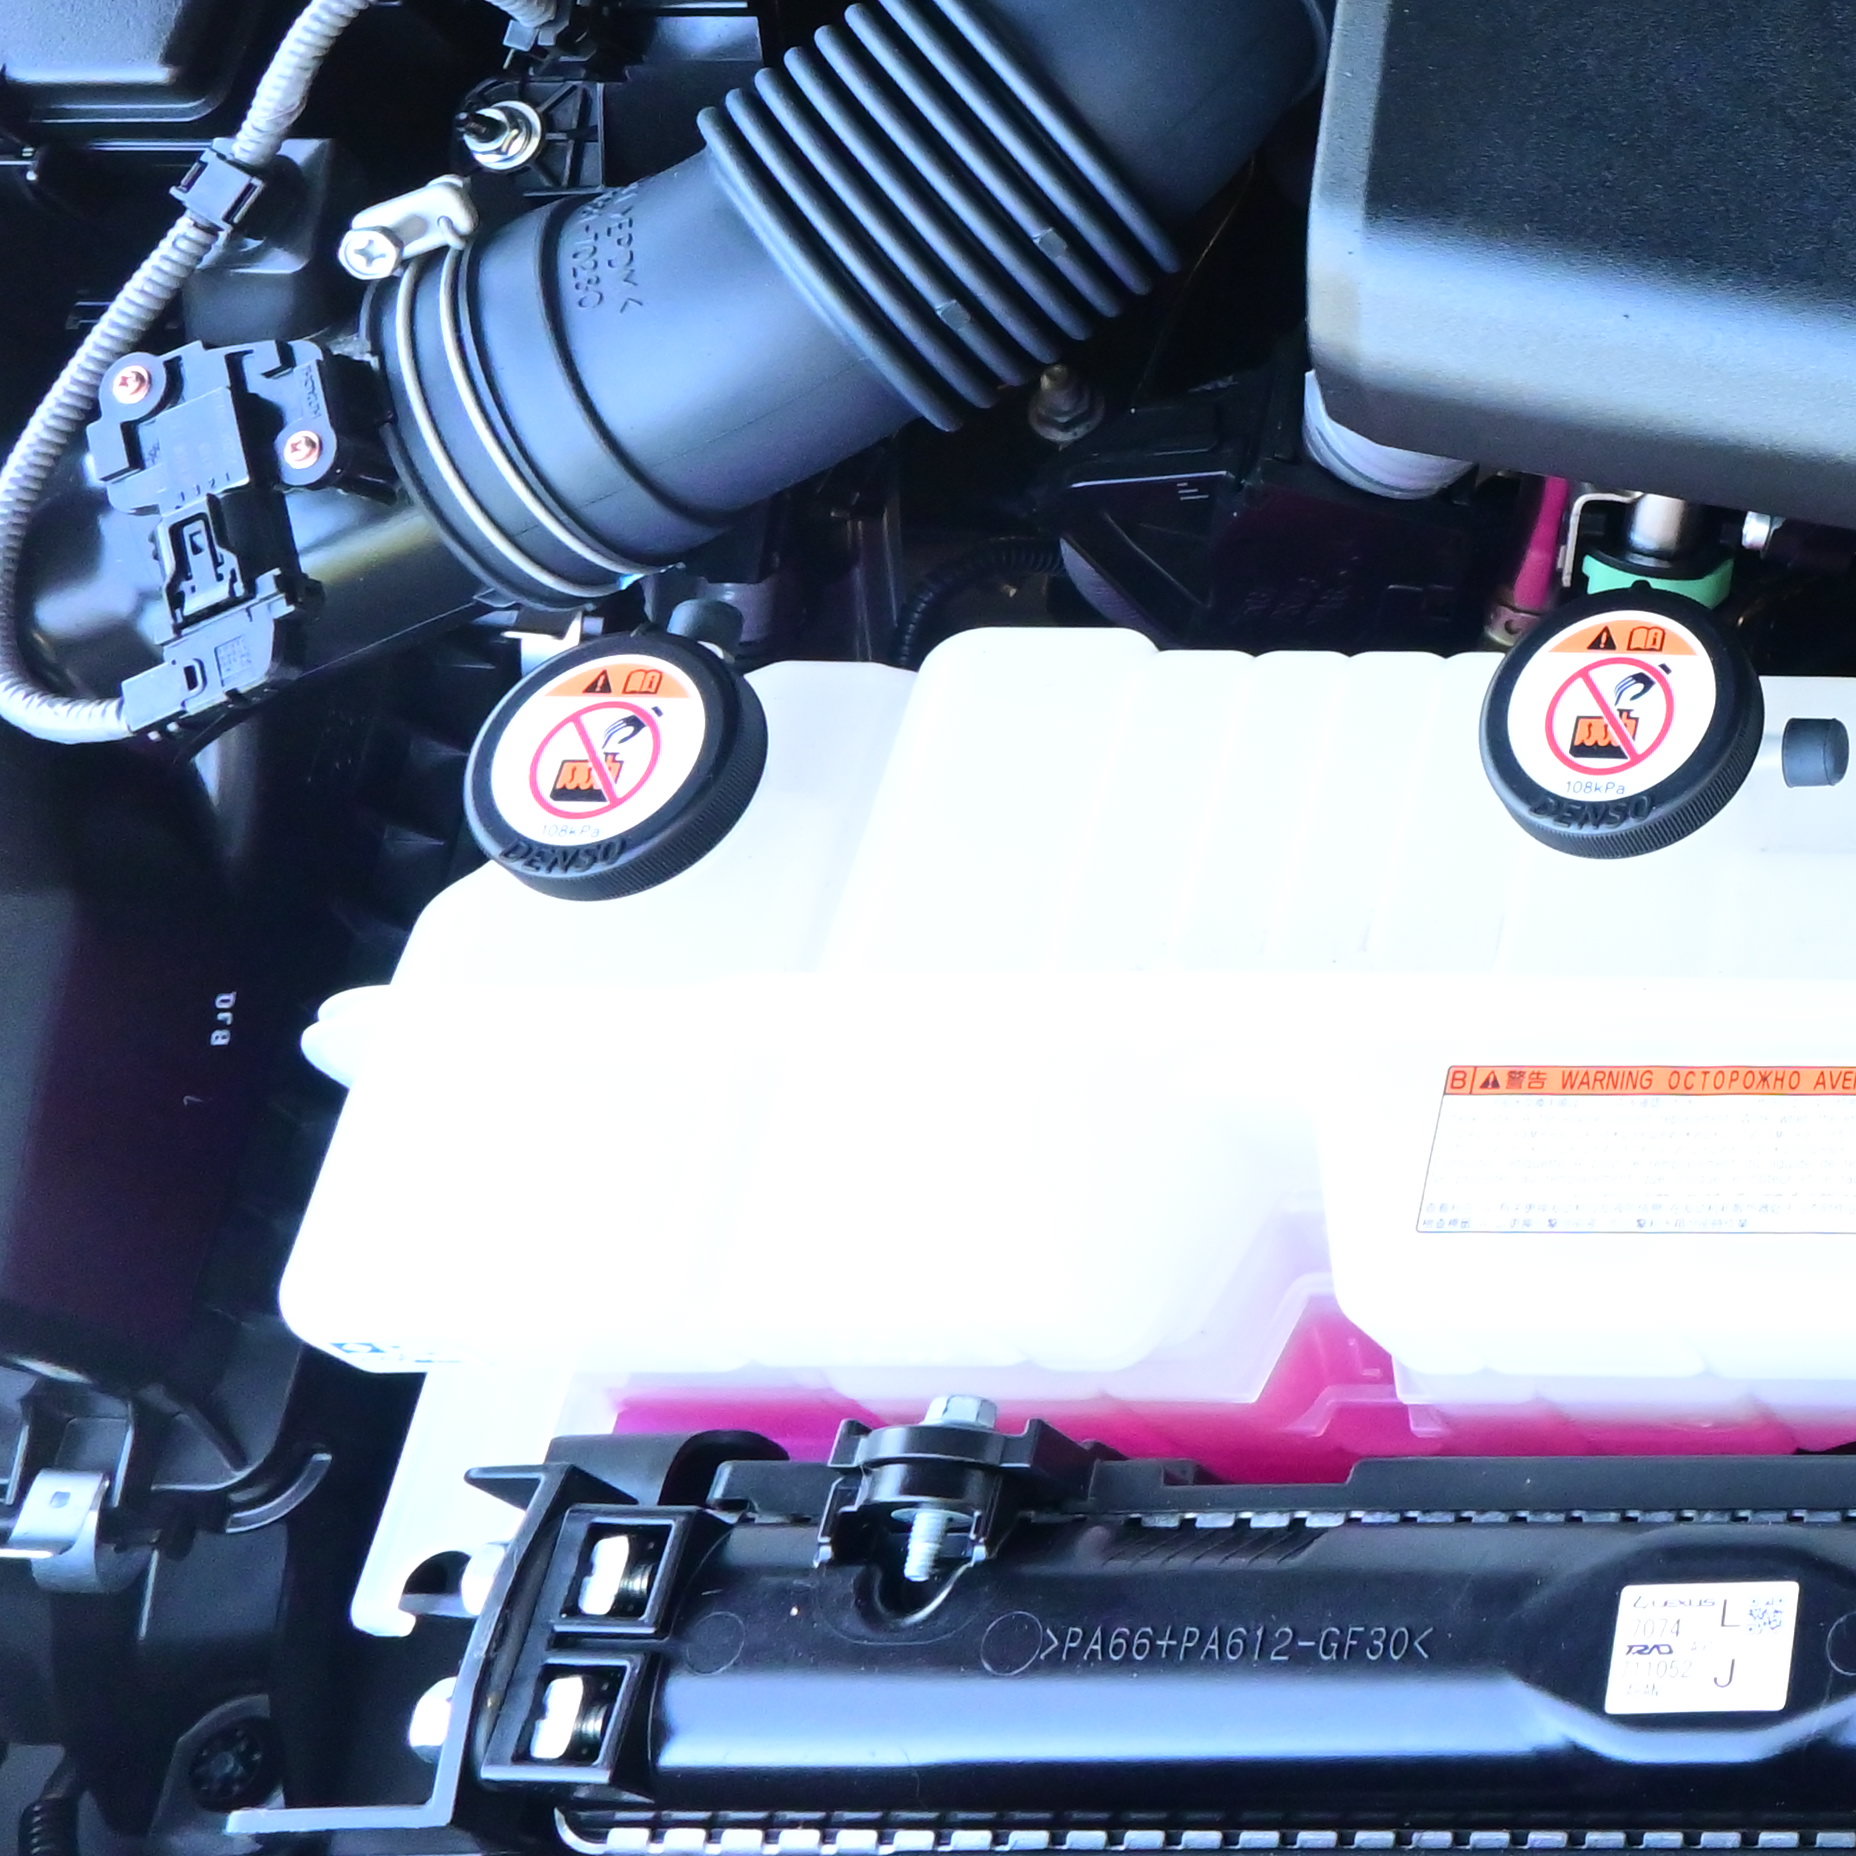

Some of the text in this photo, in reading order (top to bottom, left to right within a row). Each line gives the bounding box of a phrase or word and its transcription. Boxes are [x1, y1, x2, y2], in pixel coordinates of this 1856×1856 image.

[1565, 780, 1627, 795] 108kPa
[1528, 794, 1655, 830] DENSO
[497, 836, 629, 874] DENSO
[1450, 1070, 1467, 1090] B
[1505, 1069, 1548, 1090] 警告
[1560, 1069, 1655, 1090] WARNING
[1667, 1069, 1802, 1090] ОСТОРОЖНО
[1720, 1598, 1741, 1628] L
[1039, 1625, 1434, 1662] >PA66+PA612-GF30<
[1713, 1658, 1736, 1689] J
